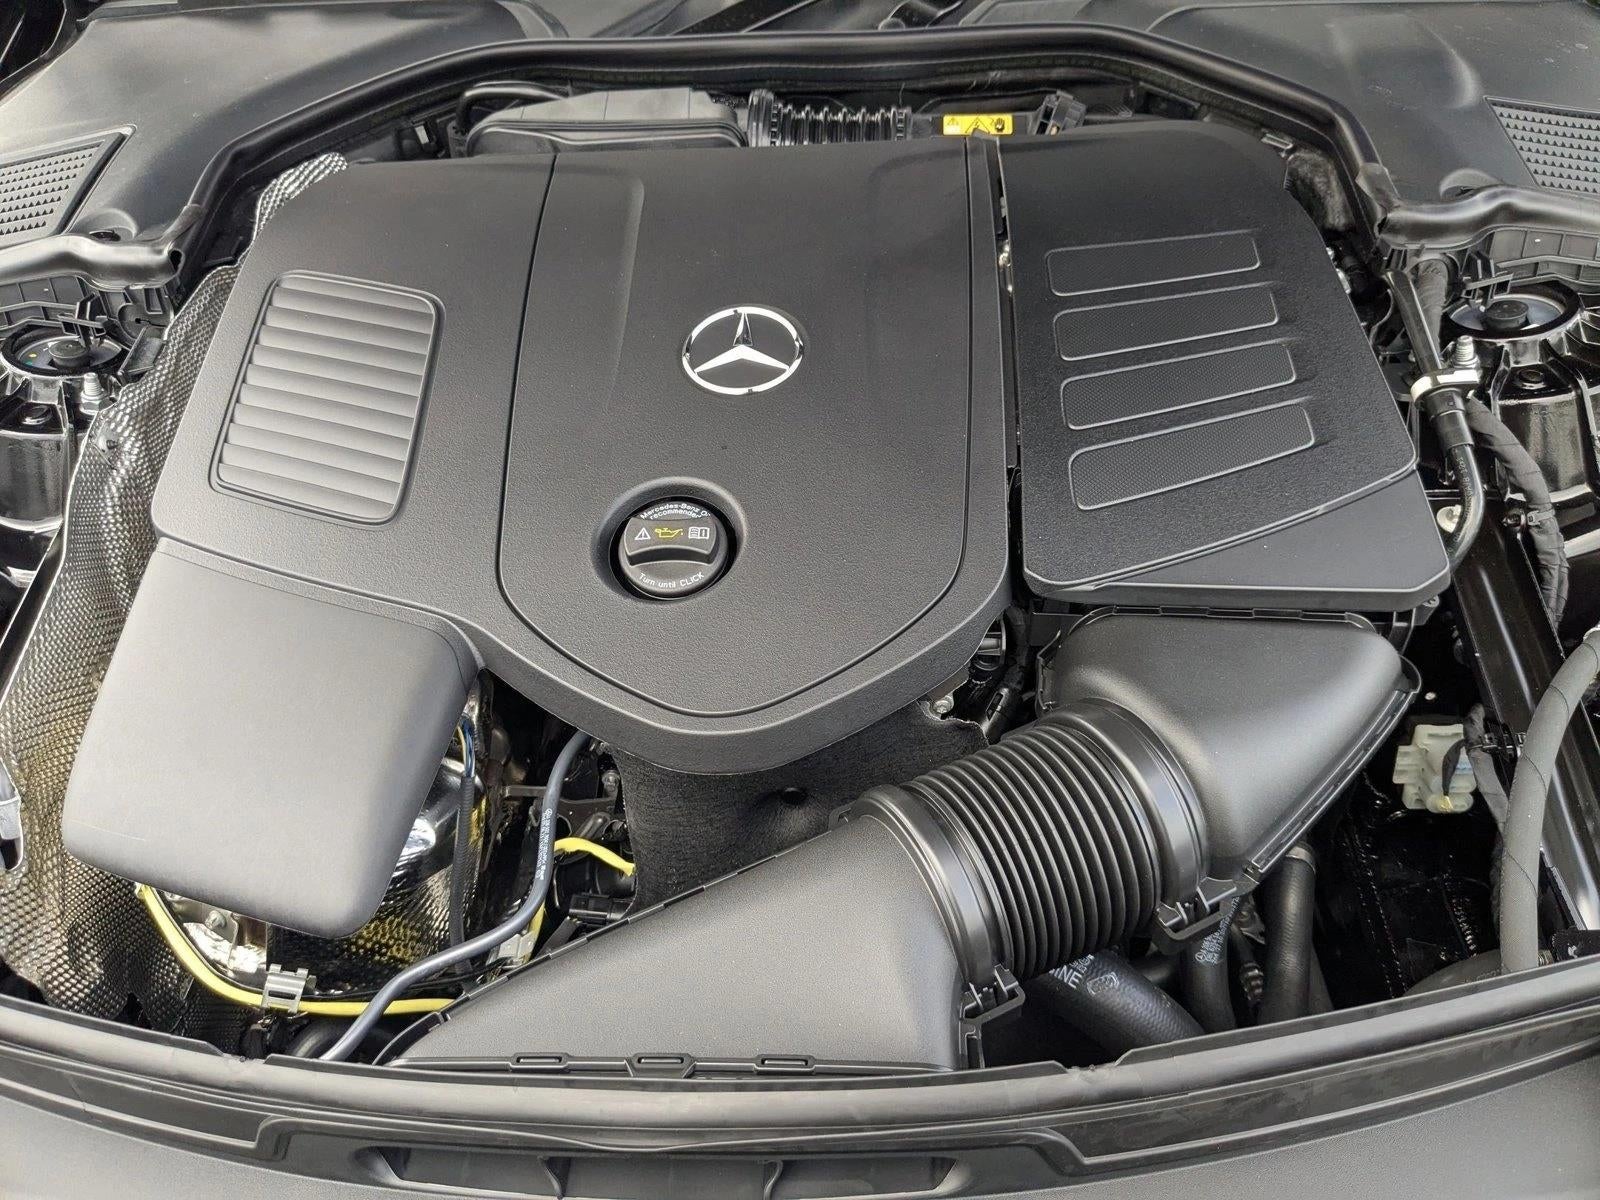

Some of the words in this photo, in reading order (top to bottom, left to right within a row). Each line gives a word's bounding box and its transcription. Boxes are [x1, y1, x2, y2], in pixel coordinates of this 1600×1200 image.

[640, 503, 700, 519] Mercedes-Benz
[639, 572, 656, 586] Turn
[679, 572, 705, 587] CLICK
